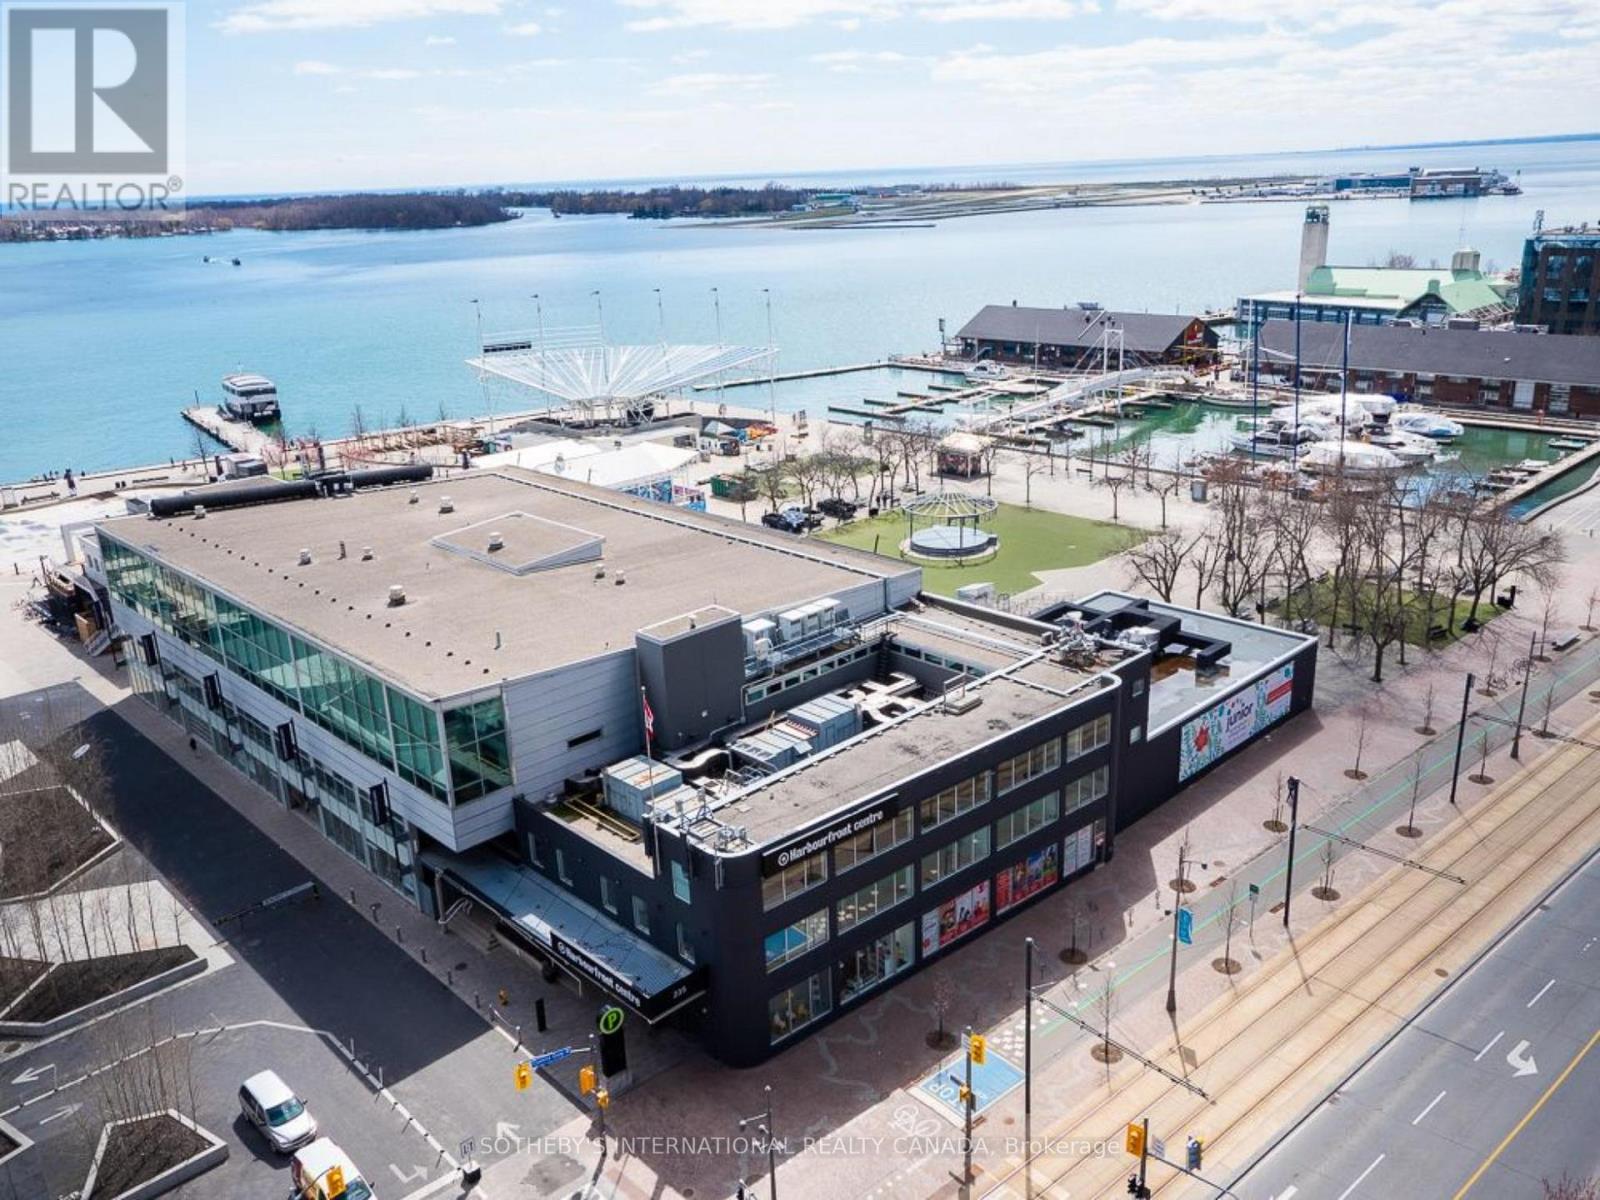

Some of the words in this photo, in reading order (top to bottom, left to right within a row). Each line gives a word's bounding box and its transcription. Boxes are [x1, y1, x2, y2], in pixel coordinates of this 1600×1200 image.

[1225, 703, 1254, 733] junior
[789, 822, 852, 862] Harbourfront
[853, 810, 884, 831] centre
[615, 984, 641, 1008] centre
[606, 1011, 618, 1029] P
